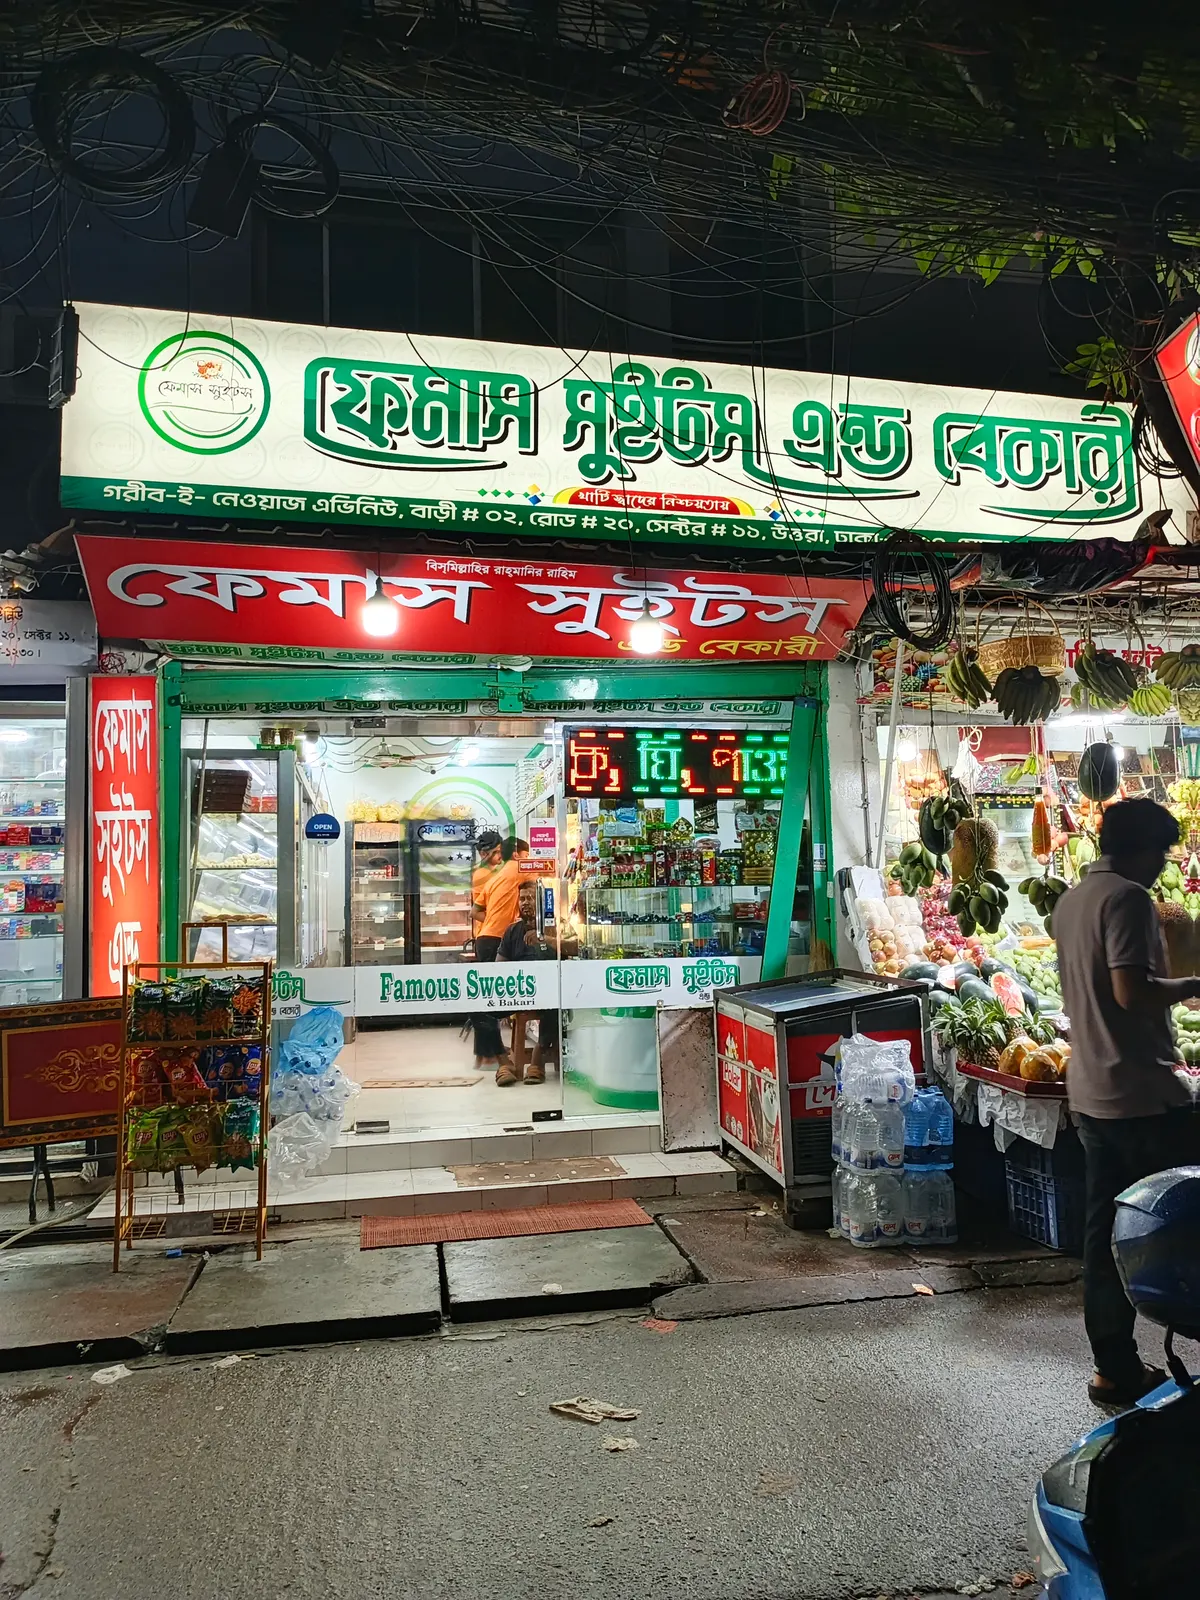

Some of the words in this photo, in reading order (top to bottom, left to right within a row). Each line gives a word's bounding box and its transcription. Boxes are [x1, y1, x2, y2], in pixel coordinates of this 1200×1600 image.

[304, 357, 538, 471] ফেমাস
[563, 362, 770, 487] সুইটস
[783, 401, 911, 481] এন্ড
[934, 404, 1143, 524] বেকারী
[212, 492, 307, 512] নেওয়াজ
[462, 508, 479, 522] #
[486, 510, 523, 526] ০২,
[530, 511, 576, 528] রোড
[581, 516, 598, 529] #
[604, 516, 640, 533] ২০,
[646, 518, 707, 536] সেক্টর
[711, 524, 727, 537] #
[547, 566, 577, 579] রাহিম
[107, 562, 494, 625] ফেমাস
[514, 571, 849, 641] সুইটস
[700, 636, 826, 655] বেকারী
[95, 688, 153, 776] ফেমাস
[94, 782, 152, 907] সুইটস
[380, 971, 461, 1002] Famous
[466, 968, 536, 999] Sweets
[605, 965, 671, 994] ফেমাস
[682, 959, 740, 995] সুইটস
[487, 1000, 495, 1008] &
[499, 998, 535, 1007] Bakari
